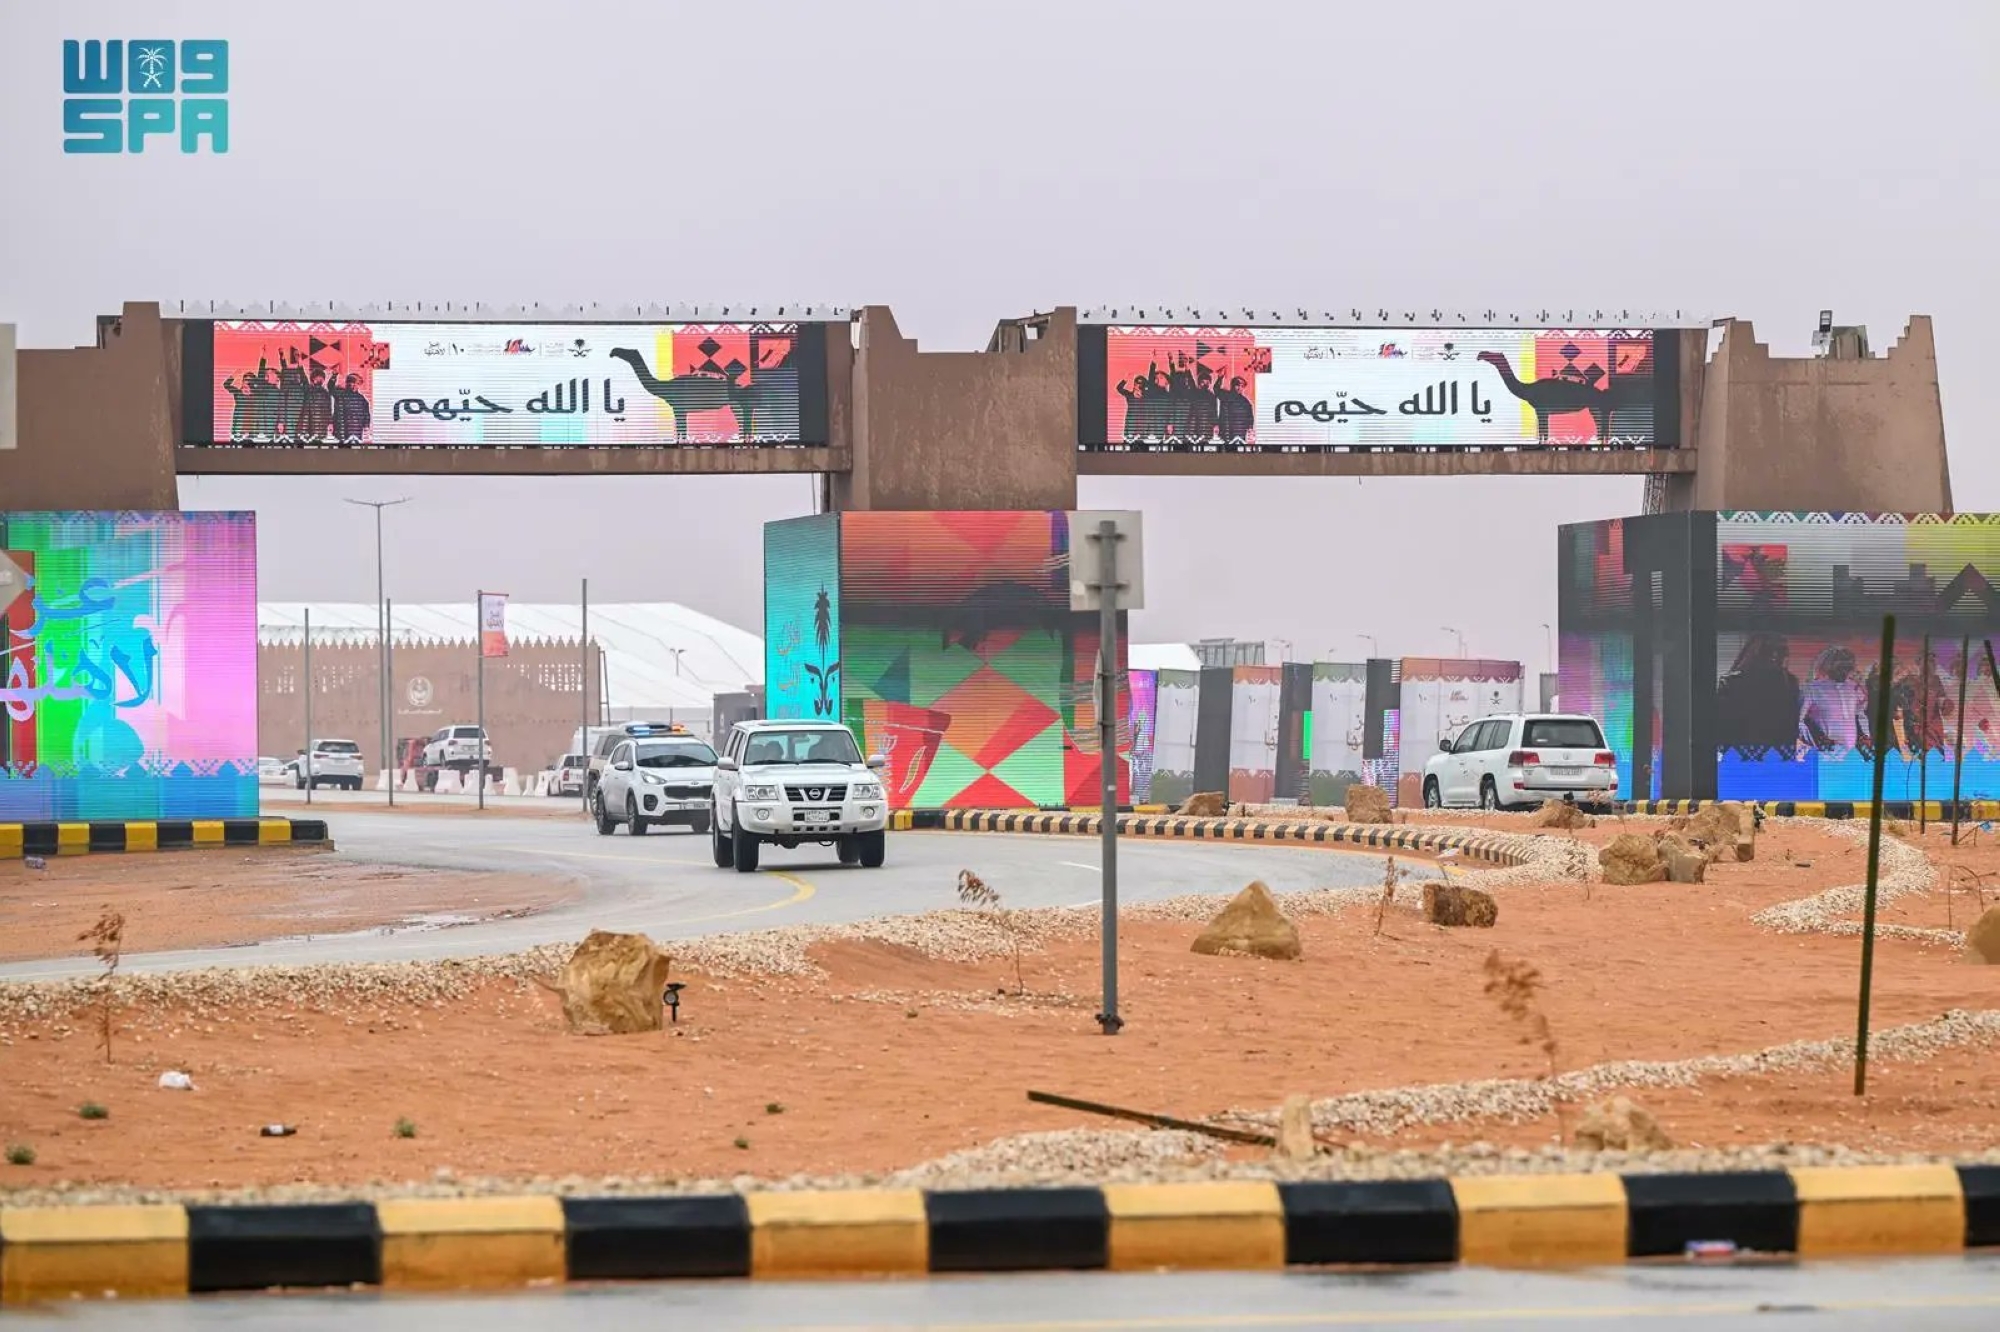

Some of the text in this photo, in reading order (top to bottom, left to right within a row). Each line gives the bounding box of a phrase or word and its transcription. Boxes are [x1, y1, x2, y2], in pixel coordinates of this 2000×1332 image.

[526, 378, 590, 414] الله
[604, 378, 626, 422] يا
[1398, 380, 1458, 415] الله
[1471, 380, 1492, 424] يا
